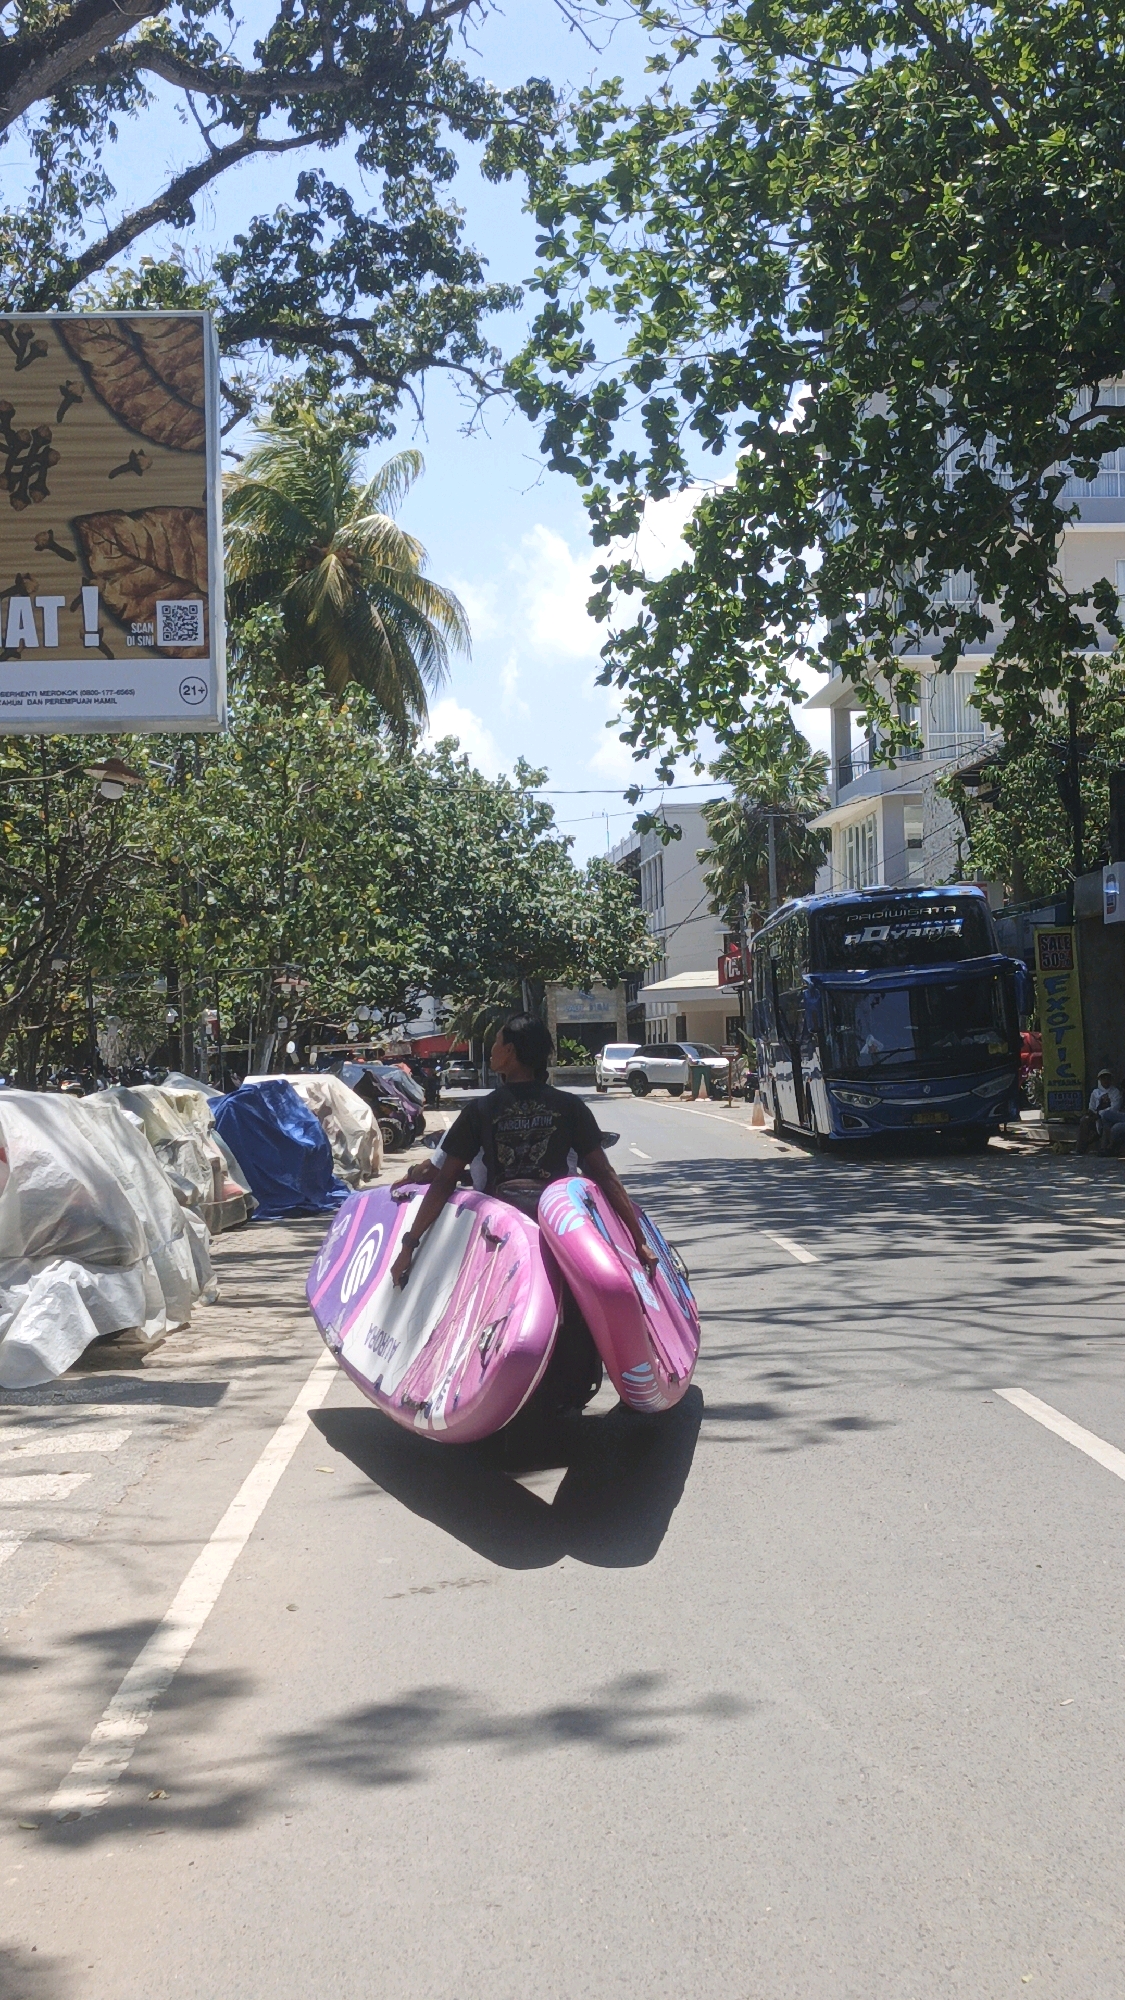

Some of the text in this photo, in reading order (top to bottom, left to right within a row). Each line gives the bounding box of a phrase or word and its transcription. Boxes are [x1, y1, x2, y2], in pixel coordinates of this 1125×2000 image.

[0, 595, 66, 648] AT
[131, 622, 154, 634] SCAN
[126, 635, 155, 647] DI SINI
[182, 685, 206, 697] 21+
[26, 698, 43, 706] DAN
[44, 697, 92, 705] PEREMPUAN
[1040, 934, 1071, 951] SALE
[1041, 951, 1072, 968] 50%
[1043, 973, 1077, 1078] EXOTIC
[364, 1323, 401, 1363] AURORA
